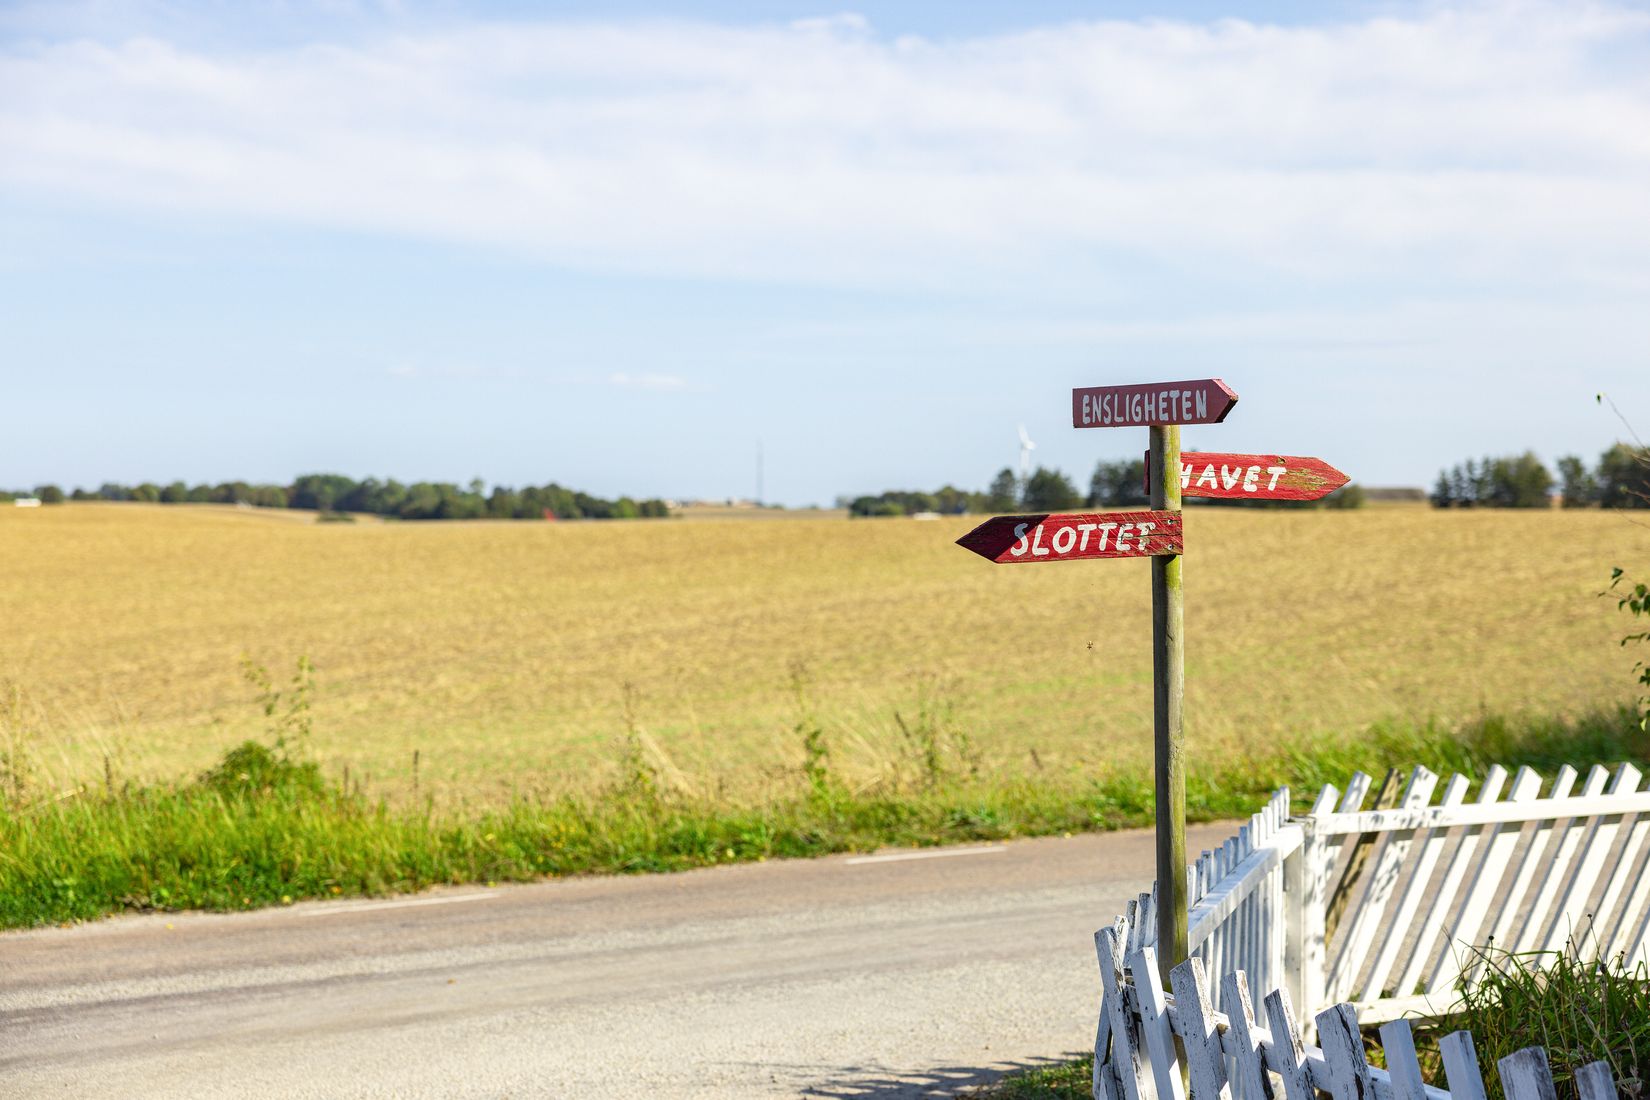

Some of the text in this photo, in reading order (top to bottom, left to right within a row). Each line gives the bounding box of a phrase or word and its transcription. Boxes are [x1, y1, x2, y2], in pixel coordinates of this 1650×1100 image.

[1082, 389, 1207, 424] ENSLIGHETEN
[1180, 462, 1287, 492] HAVET
[1010, 522, 1156, 556] SLOTTET
